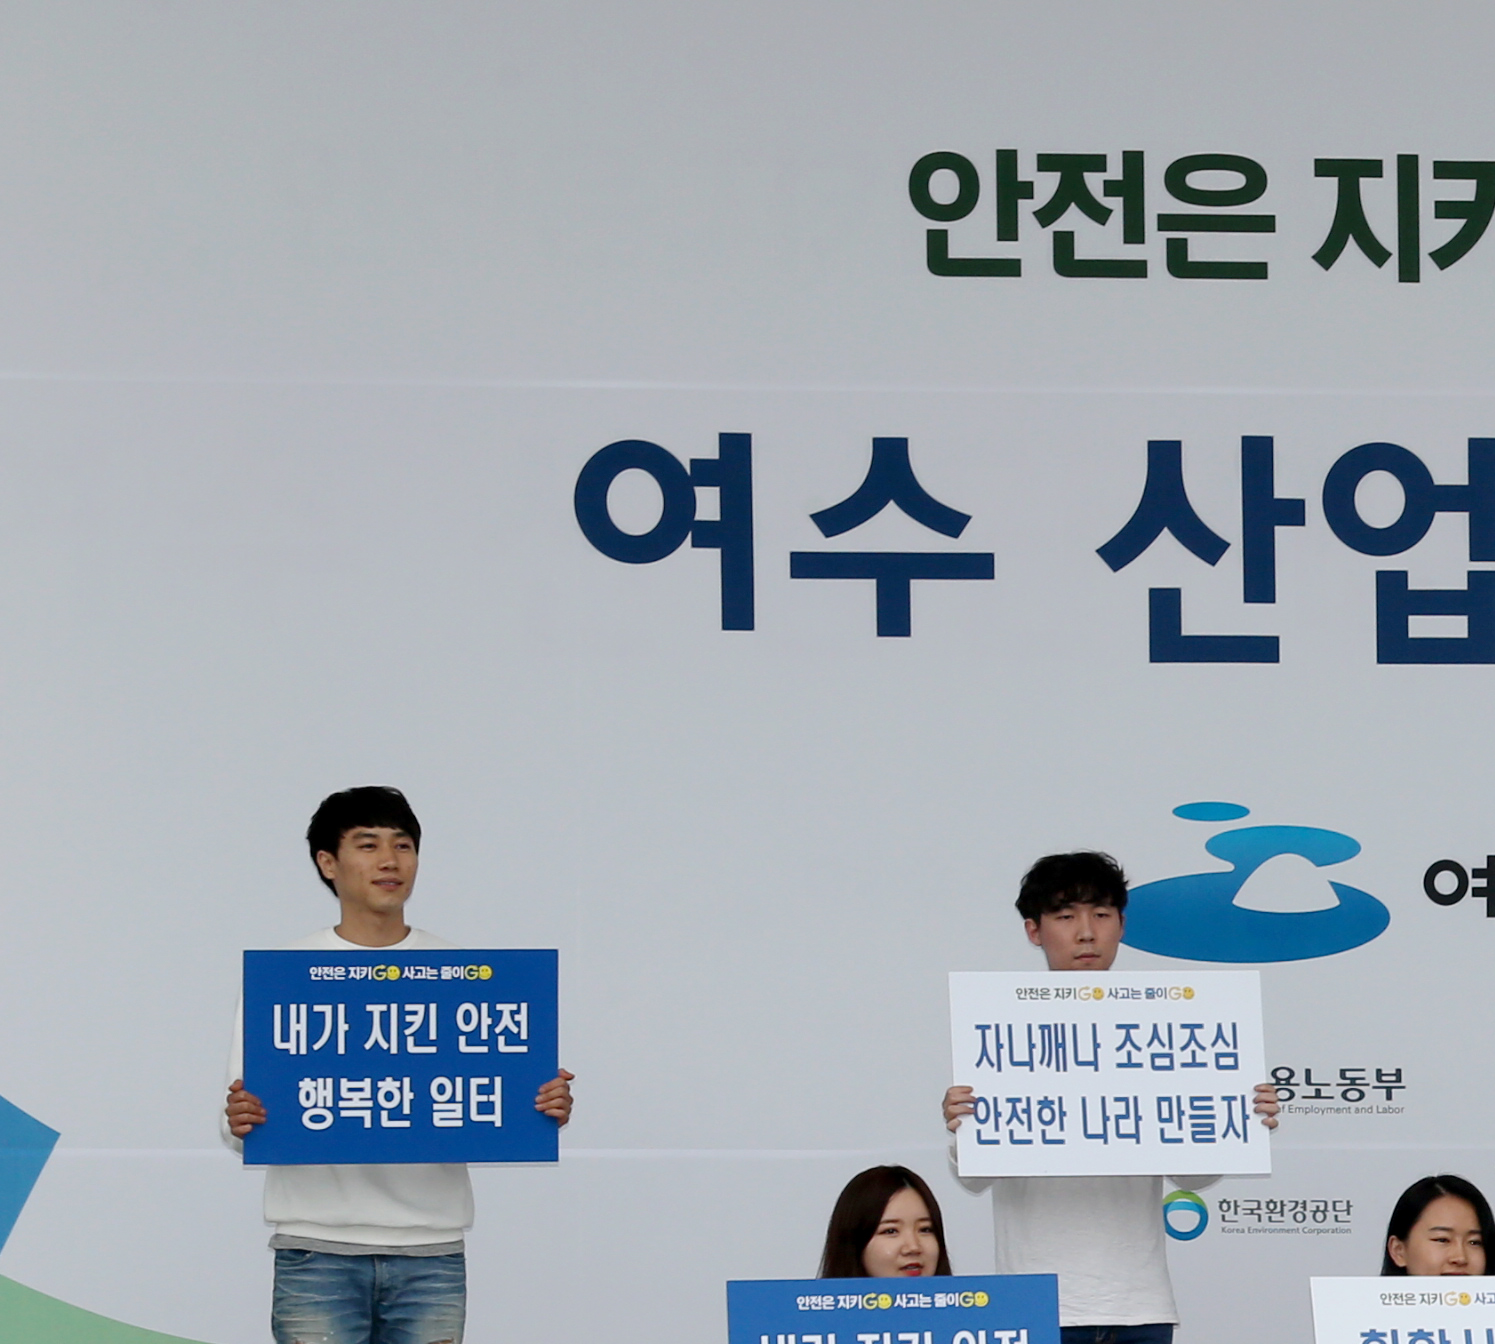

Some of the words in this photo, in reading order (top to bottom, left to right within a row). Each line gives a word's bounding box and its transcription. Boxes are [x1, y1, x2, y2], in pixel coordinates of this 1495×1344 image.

[908, 149, 1276, 280] 안전은
[573, 432, 995, 638] 여수
[309, 966, 346, 981] 안전은
[402, 965, 439, 981] 사고는
[1016, 988, 1051, 1000] 안전은
[1107, 988, 1142, 1000] 사고는
[274, 1004, 349, 1054] 내가
[364, 1003, 437, 1054] 지킨
[456, 1002, 528, 1053] 안전
[975, 1023, 1101, 1072] 자나깨나
[1115, 1022, 1239, 1071] 조심조심
[1270, 1066, 1406, 1103] 용노동부
[299, 1077, 414, 1130] 행복한
[430, 1076, 502, 1127] 일터
[1288, 1105, 1352, 1115] Employment
[1355, 1105, 1373, 1114] and
[1376, 1105, 1405, 1114] Labor
[1081, 1096, 1142, 1145] 나라
[1156, 1094, 1250, 1144] 만들자
[1218, 1199, 1353, 1224] 한국환경공단
[1221, 1227, 1245, 1235] Korea
[1247, 1227, 1300, 1235] Environment
[1302, 1227, 1352, 1235] Corporation
[796, 1294, 835, 1311] 안전은
[893, 1293, 932, 1310] 사고는
[1380, 1293, 1416, 1305] 안전은
